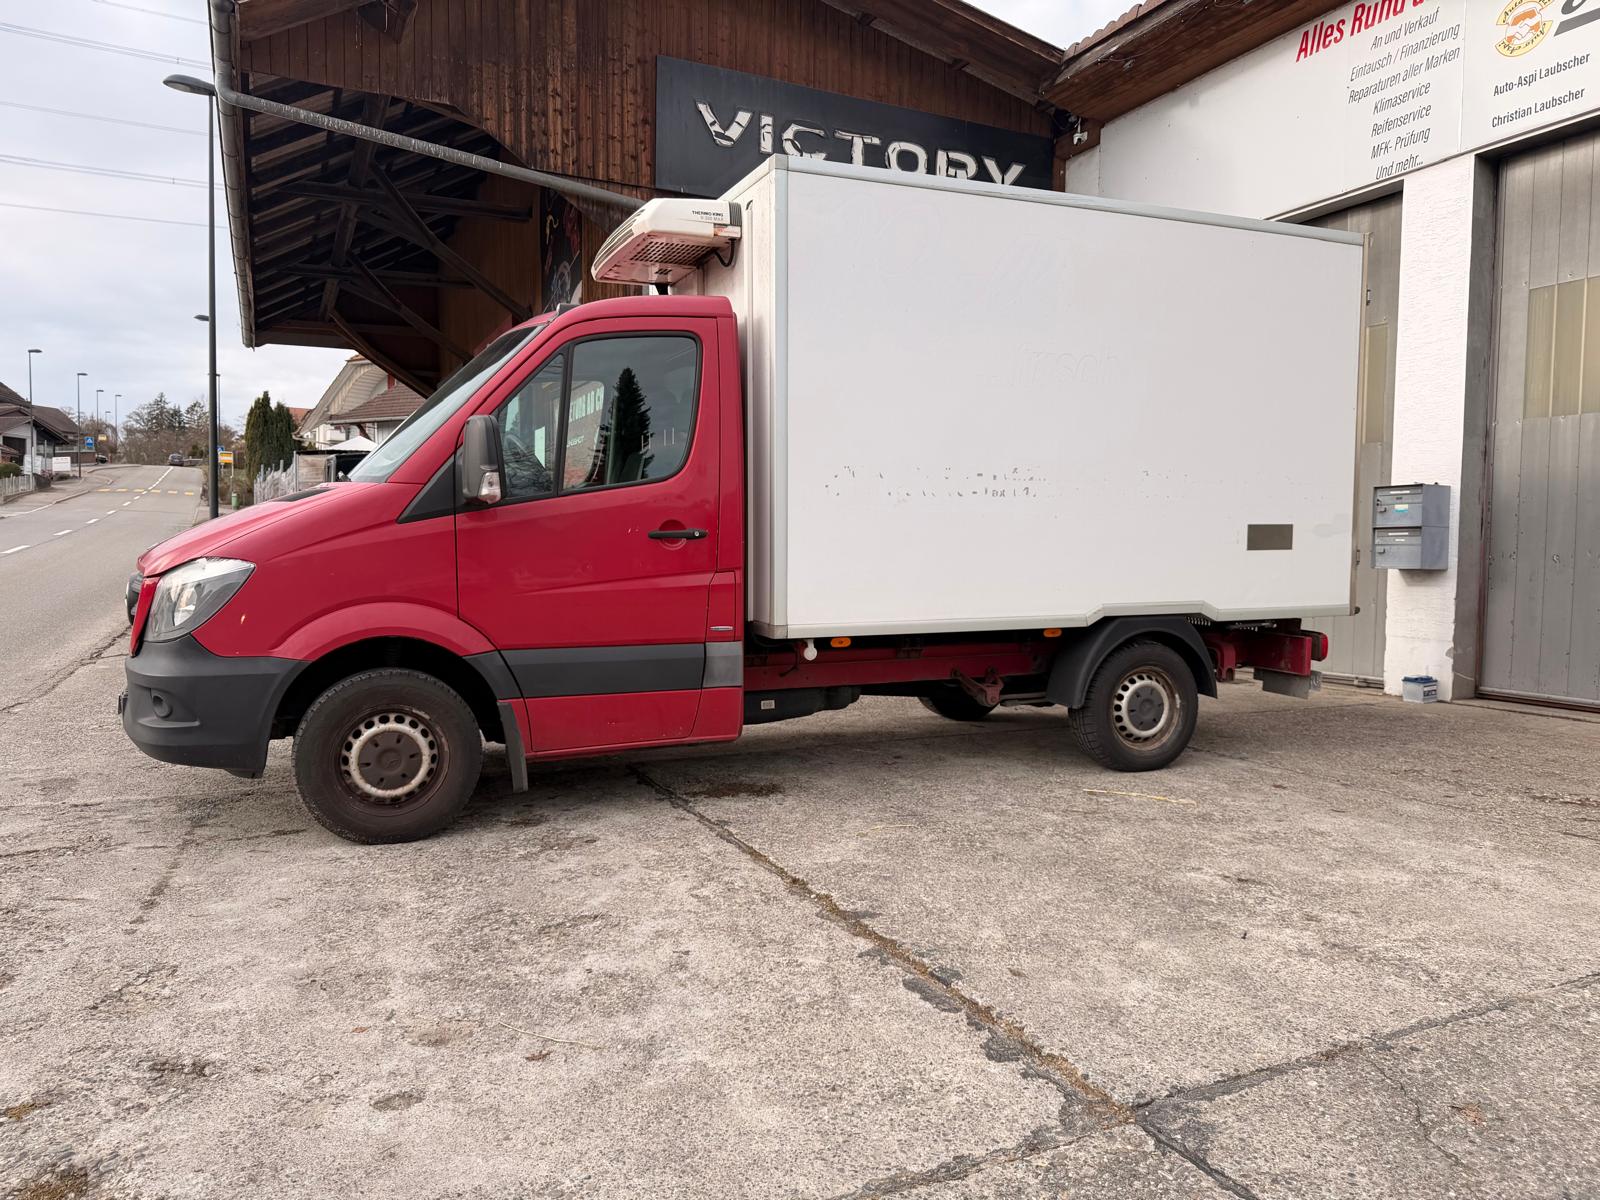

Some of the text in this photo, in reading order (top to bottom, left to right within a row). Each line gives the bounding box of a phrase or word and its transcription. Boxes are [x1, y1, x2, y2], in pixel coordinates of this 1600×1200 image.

[1296, 19, 1345, 62] Alles
[1370, 6, 1440, 50] An und Verkauf
[1350, 52, 1392, 82] Eintausch
[1400, 24, 1460, 60] Finanzierung
[1493, 53, 1590, 96] Auto-Aspi Laubscher
[1348, 47, 1460, 104] Reparaturen aller Marken
[1373, 82, 1431, 115] Klimaservice
[1491, 88, 1585, 128] Christian Laubscher
[696, 100, 1025, 184] VICTORY
[1371, 104, 1431, 138] Reifenservice
[1394, 127, 1431, 151] Prüfung
[1375, 161, 1394, 180] Und
